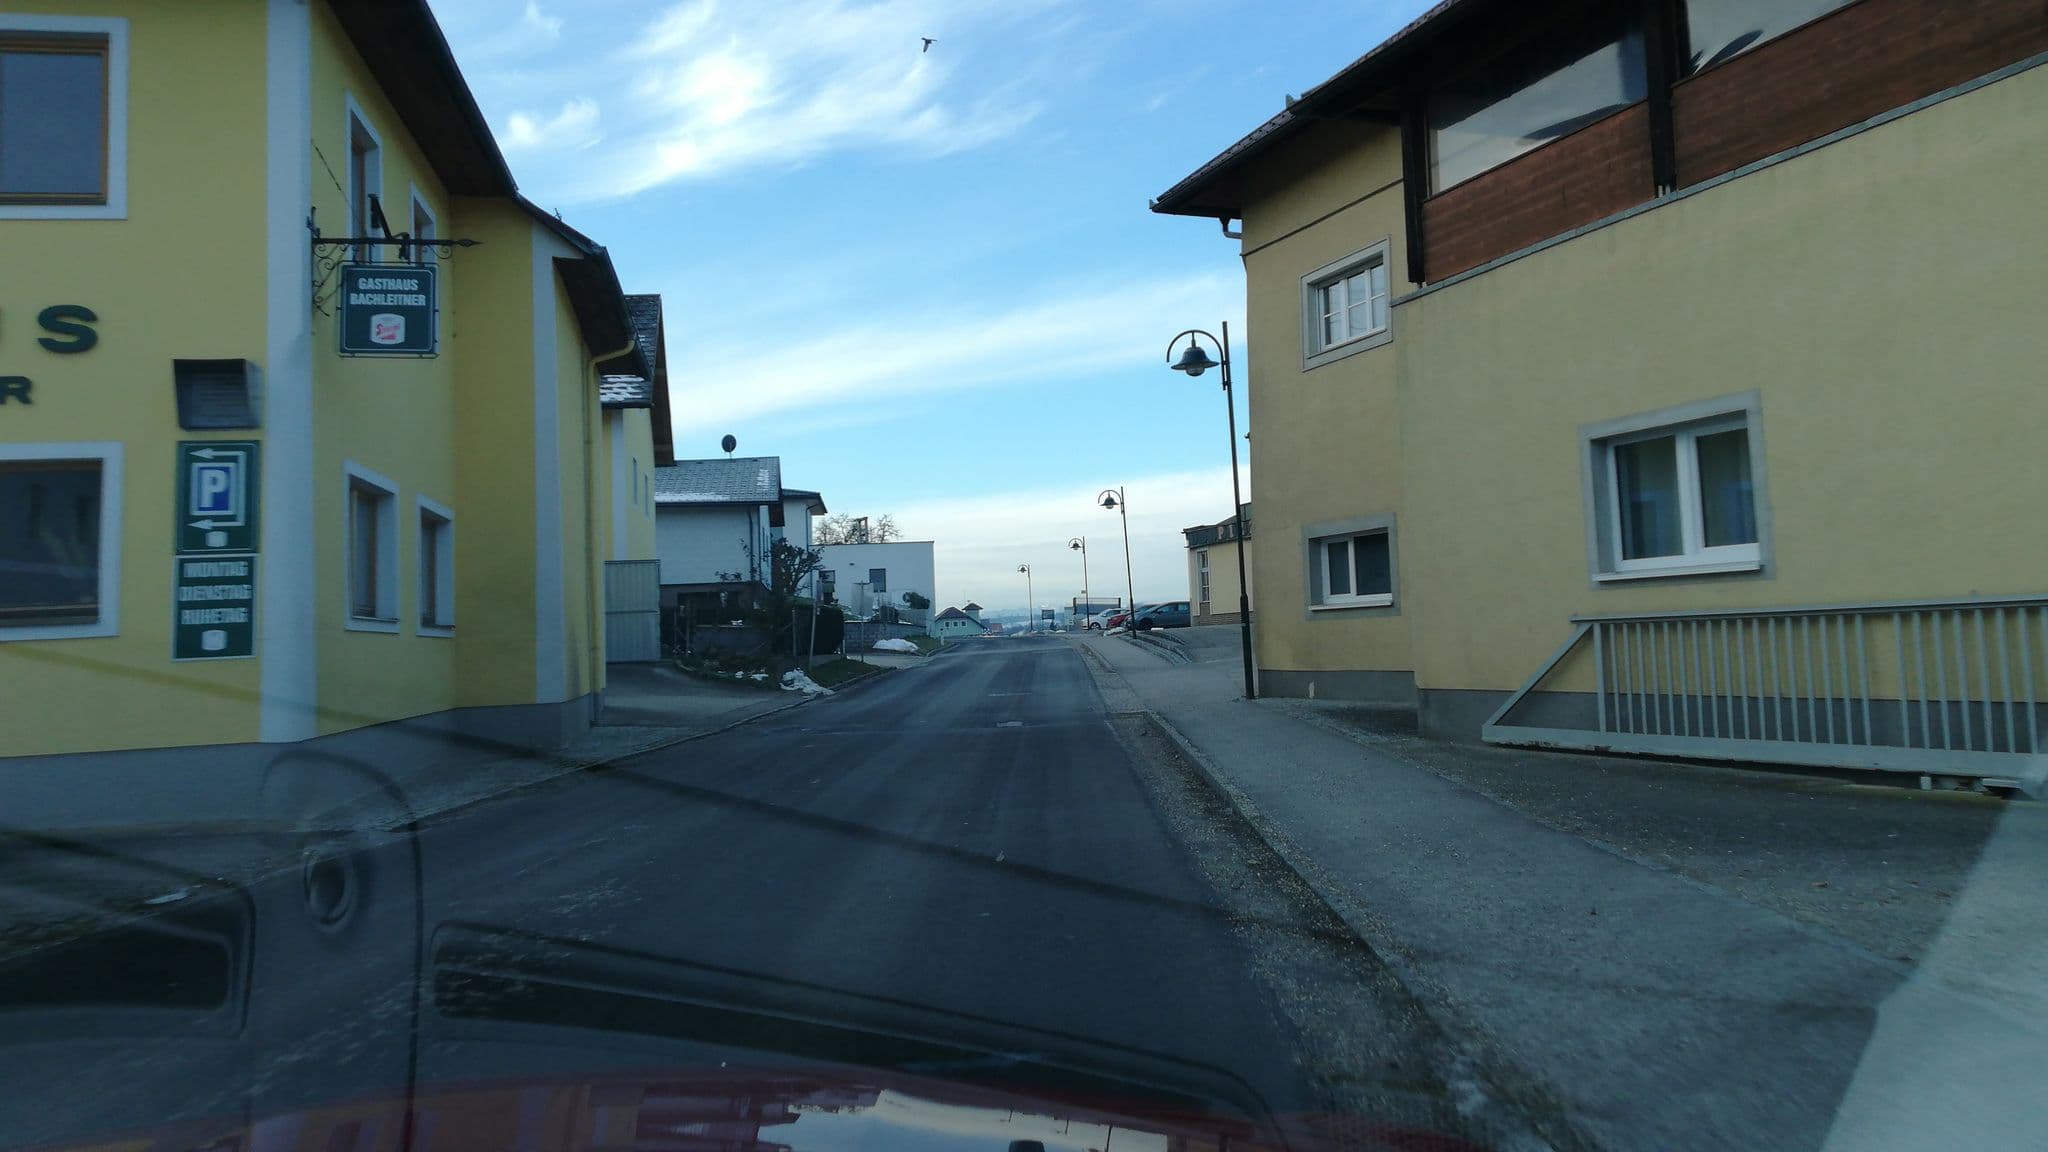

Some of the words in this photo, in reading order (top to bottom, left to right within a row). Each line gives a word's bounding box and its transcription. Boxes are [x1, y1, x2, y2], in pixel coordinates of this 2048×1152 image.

[358, 277, 419, 290] GASTHAUS
[349, 293, 427, 306] BACHLEITNER
[199, 469, 228, 508] P
